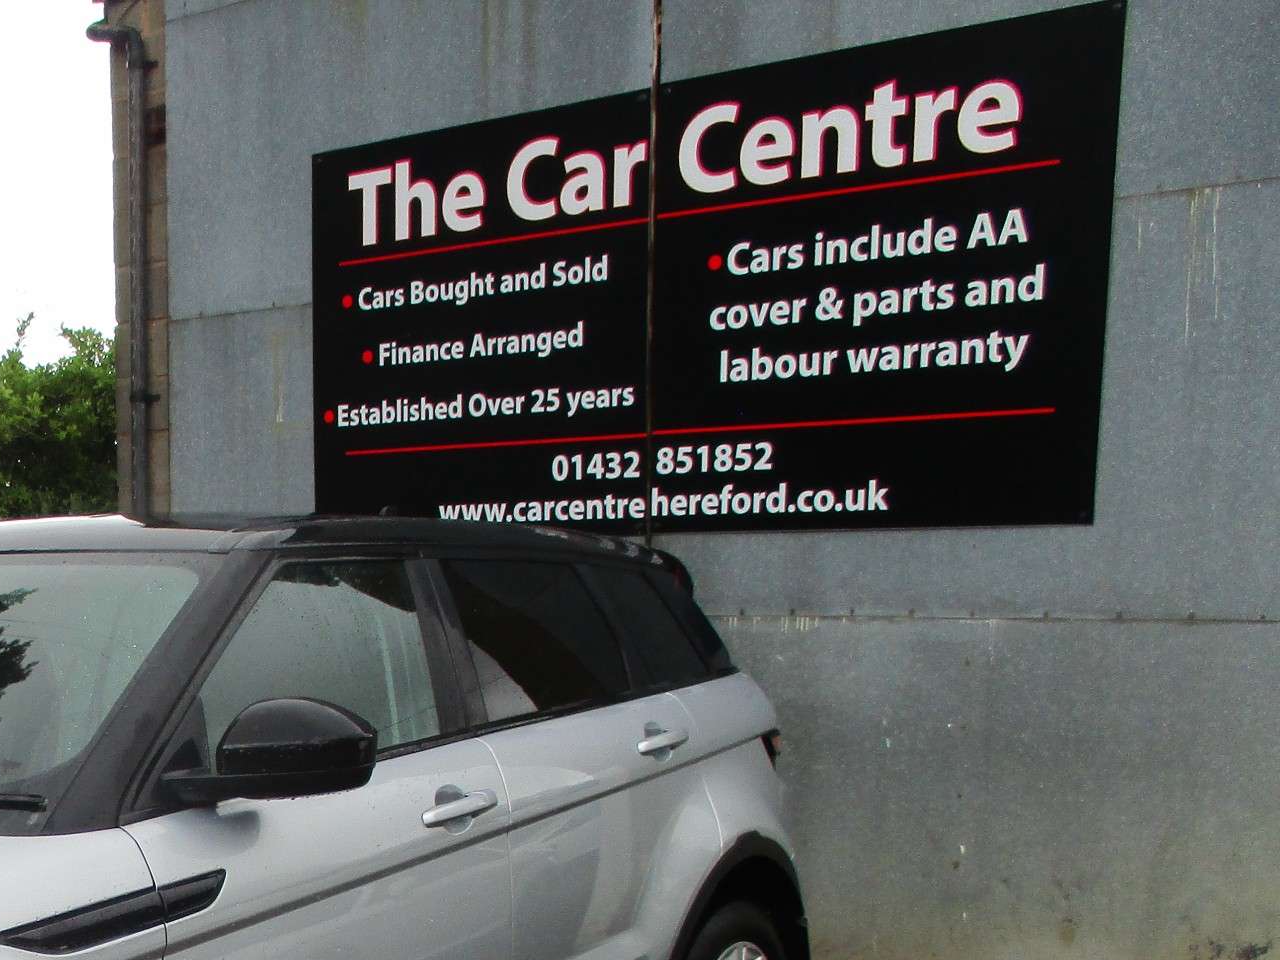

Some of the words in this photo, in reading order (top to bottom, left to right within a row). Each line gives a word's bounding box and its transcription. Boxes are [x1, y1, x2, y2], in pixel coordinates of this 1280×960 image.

[347, 157, 486, 247] The
[506, 135, 649, 221] Car
[678, 78, 1023, 194] Centre
[726, 241, 804, 276] Cars
[814, 217, 958, 267] include
[967, 208, 1029, 250] AA
[358, 286, 405, 311] Cars
[410, 272, 495, 306] Bought
[500, 262, 546, 293] and
[552, 254, 609, 287] Sold
[709, 296, 806, 331] cover
[814, 287, 844, 321] &
[852, 278, 955, 327] parts
[964, 263, 1046, 307] and
[378, 341, 464, 367] Finance
[469, 320, 584, 358] Arranged
[719, 347, 838, 383] labour
[847, 330, 1030, 374] warranty
[337, 393, 463, 428] Established
[468, 392, 526, 417] Over
[531, 387, 560, 413] 25
[566, 385, 635, 417] years
[551, 450, 641, 482] 01432
[655, 441, 773, 475] 851852
